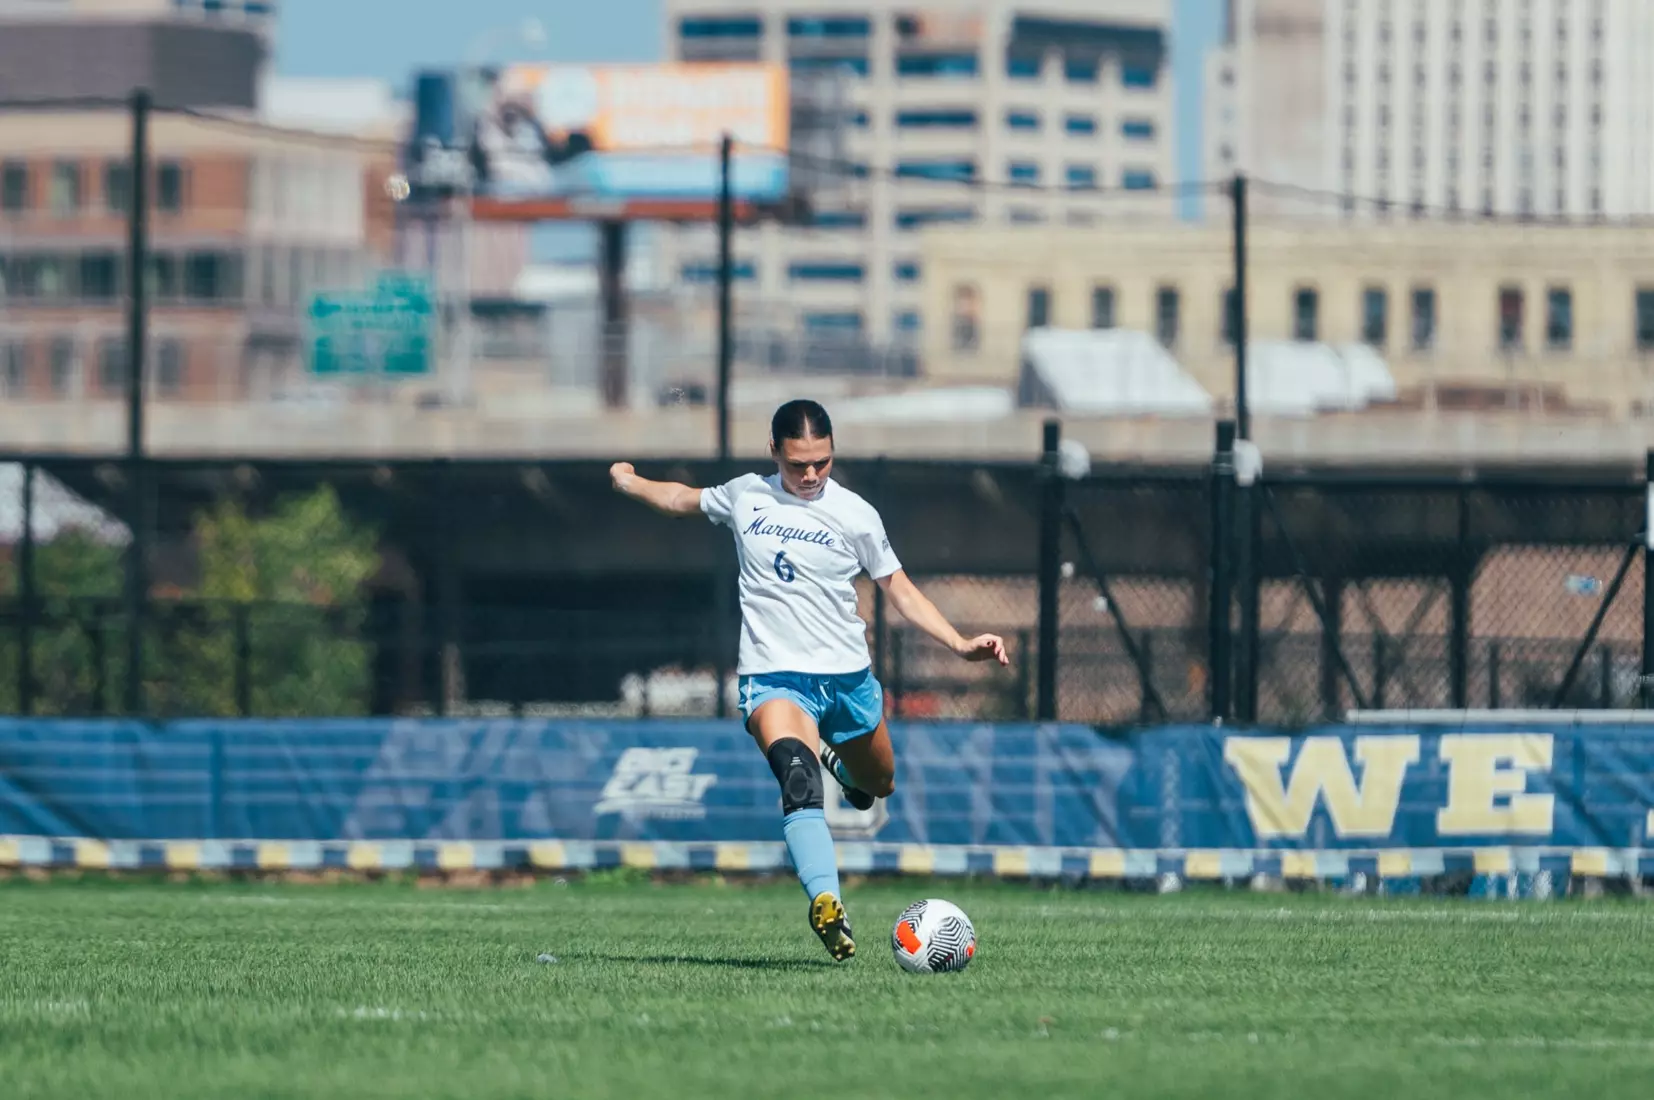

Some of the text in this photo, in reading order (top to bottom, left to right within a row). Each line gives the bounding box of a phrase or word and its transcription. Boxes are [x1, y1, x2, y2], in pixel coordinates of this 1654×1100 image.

[743, 515, 836, 548] Marquette
[773, 550, 795, 583] 6
[1225, 734, 1554, 837] WE
